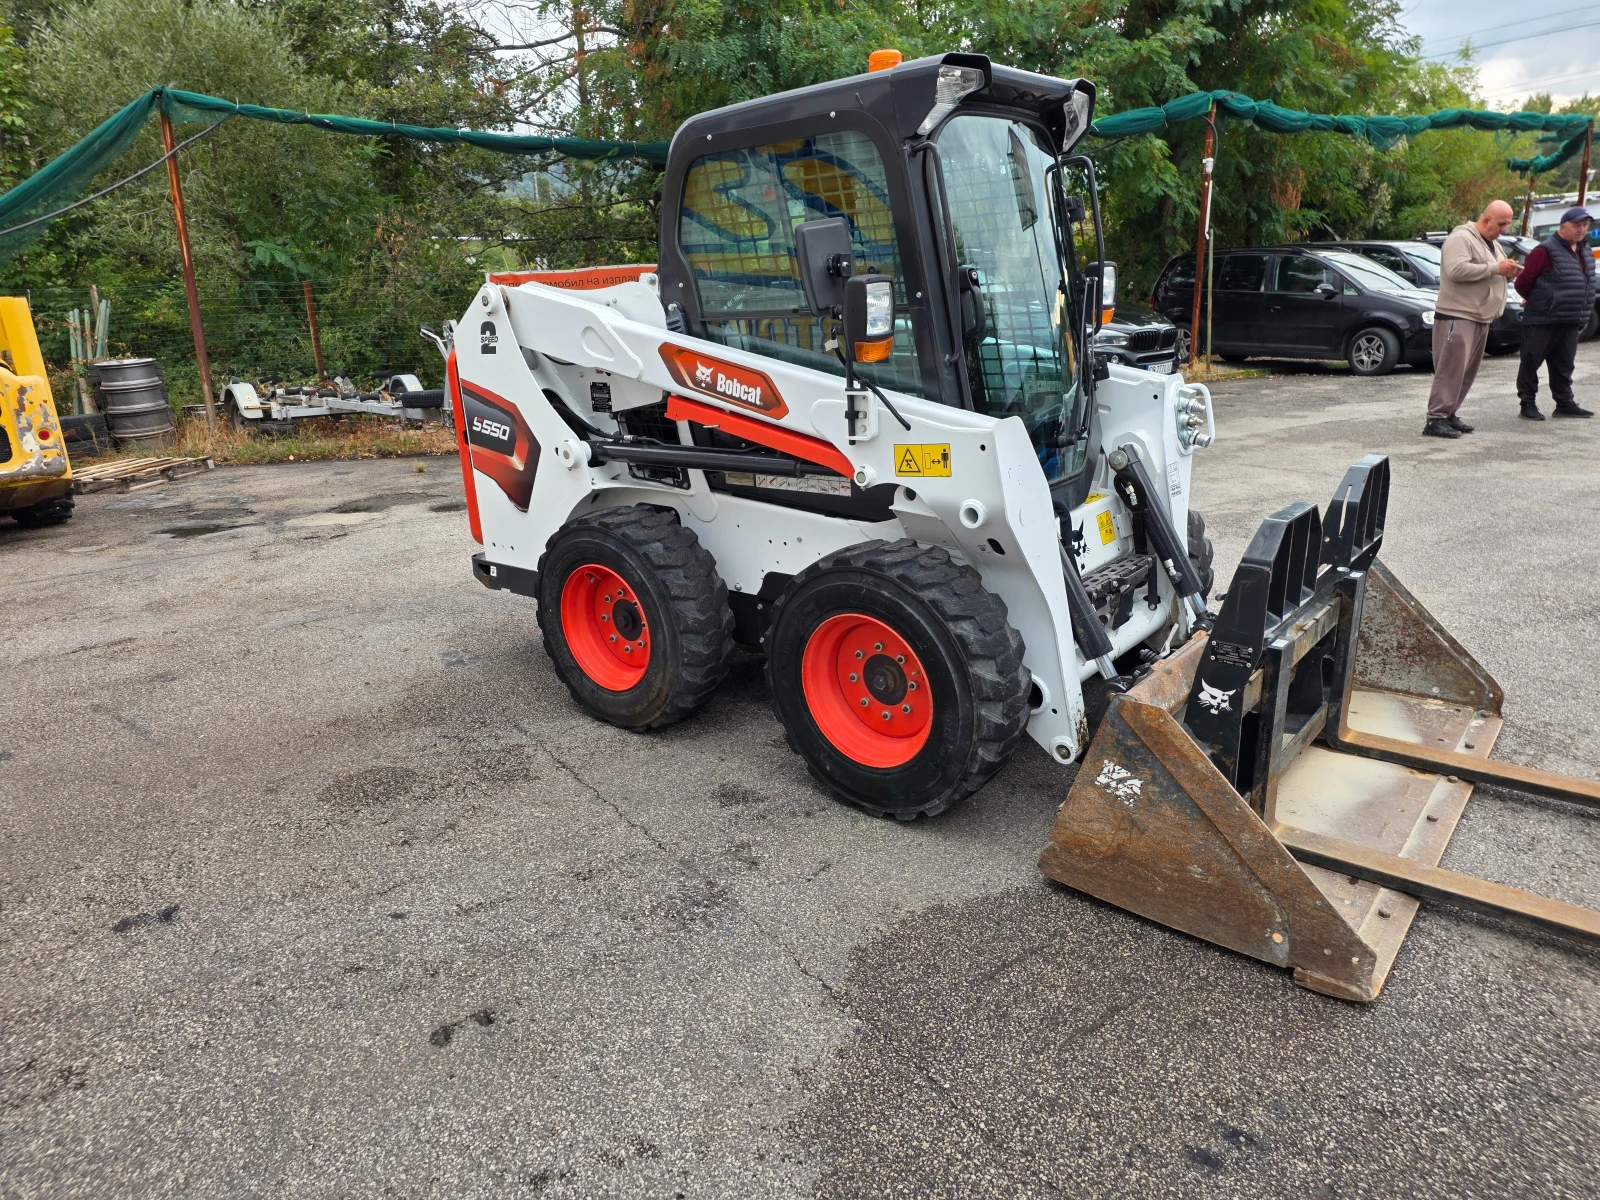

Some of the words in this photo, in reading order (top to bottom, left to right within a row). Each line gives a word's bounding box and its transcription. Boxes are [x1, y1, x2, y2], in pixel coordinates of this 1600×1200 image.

[586, 277, 600, 286] на
[480, 320, 497, 355] 2
[480, 335, 499, 344] SPEED
[716, 372, 762, 406] Bobcat
[472, 416, 511, 441] S550
